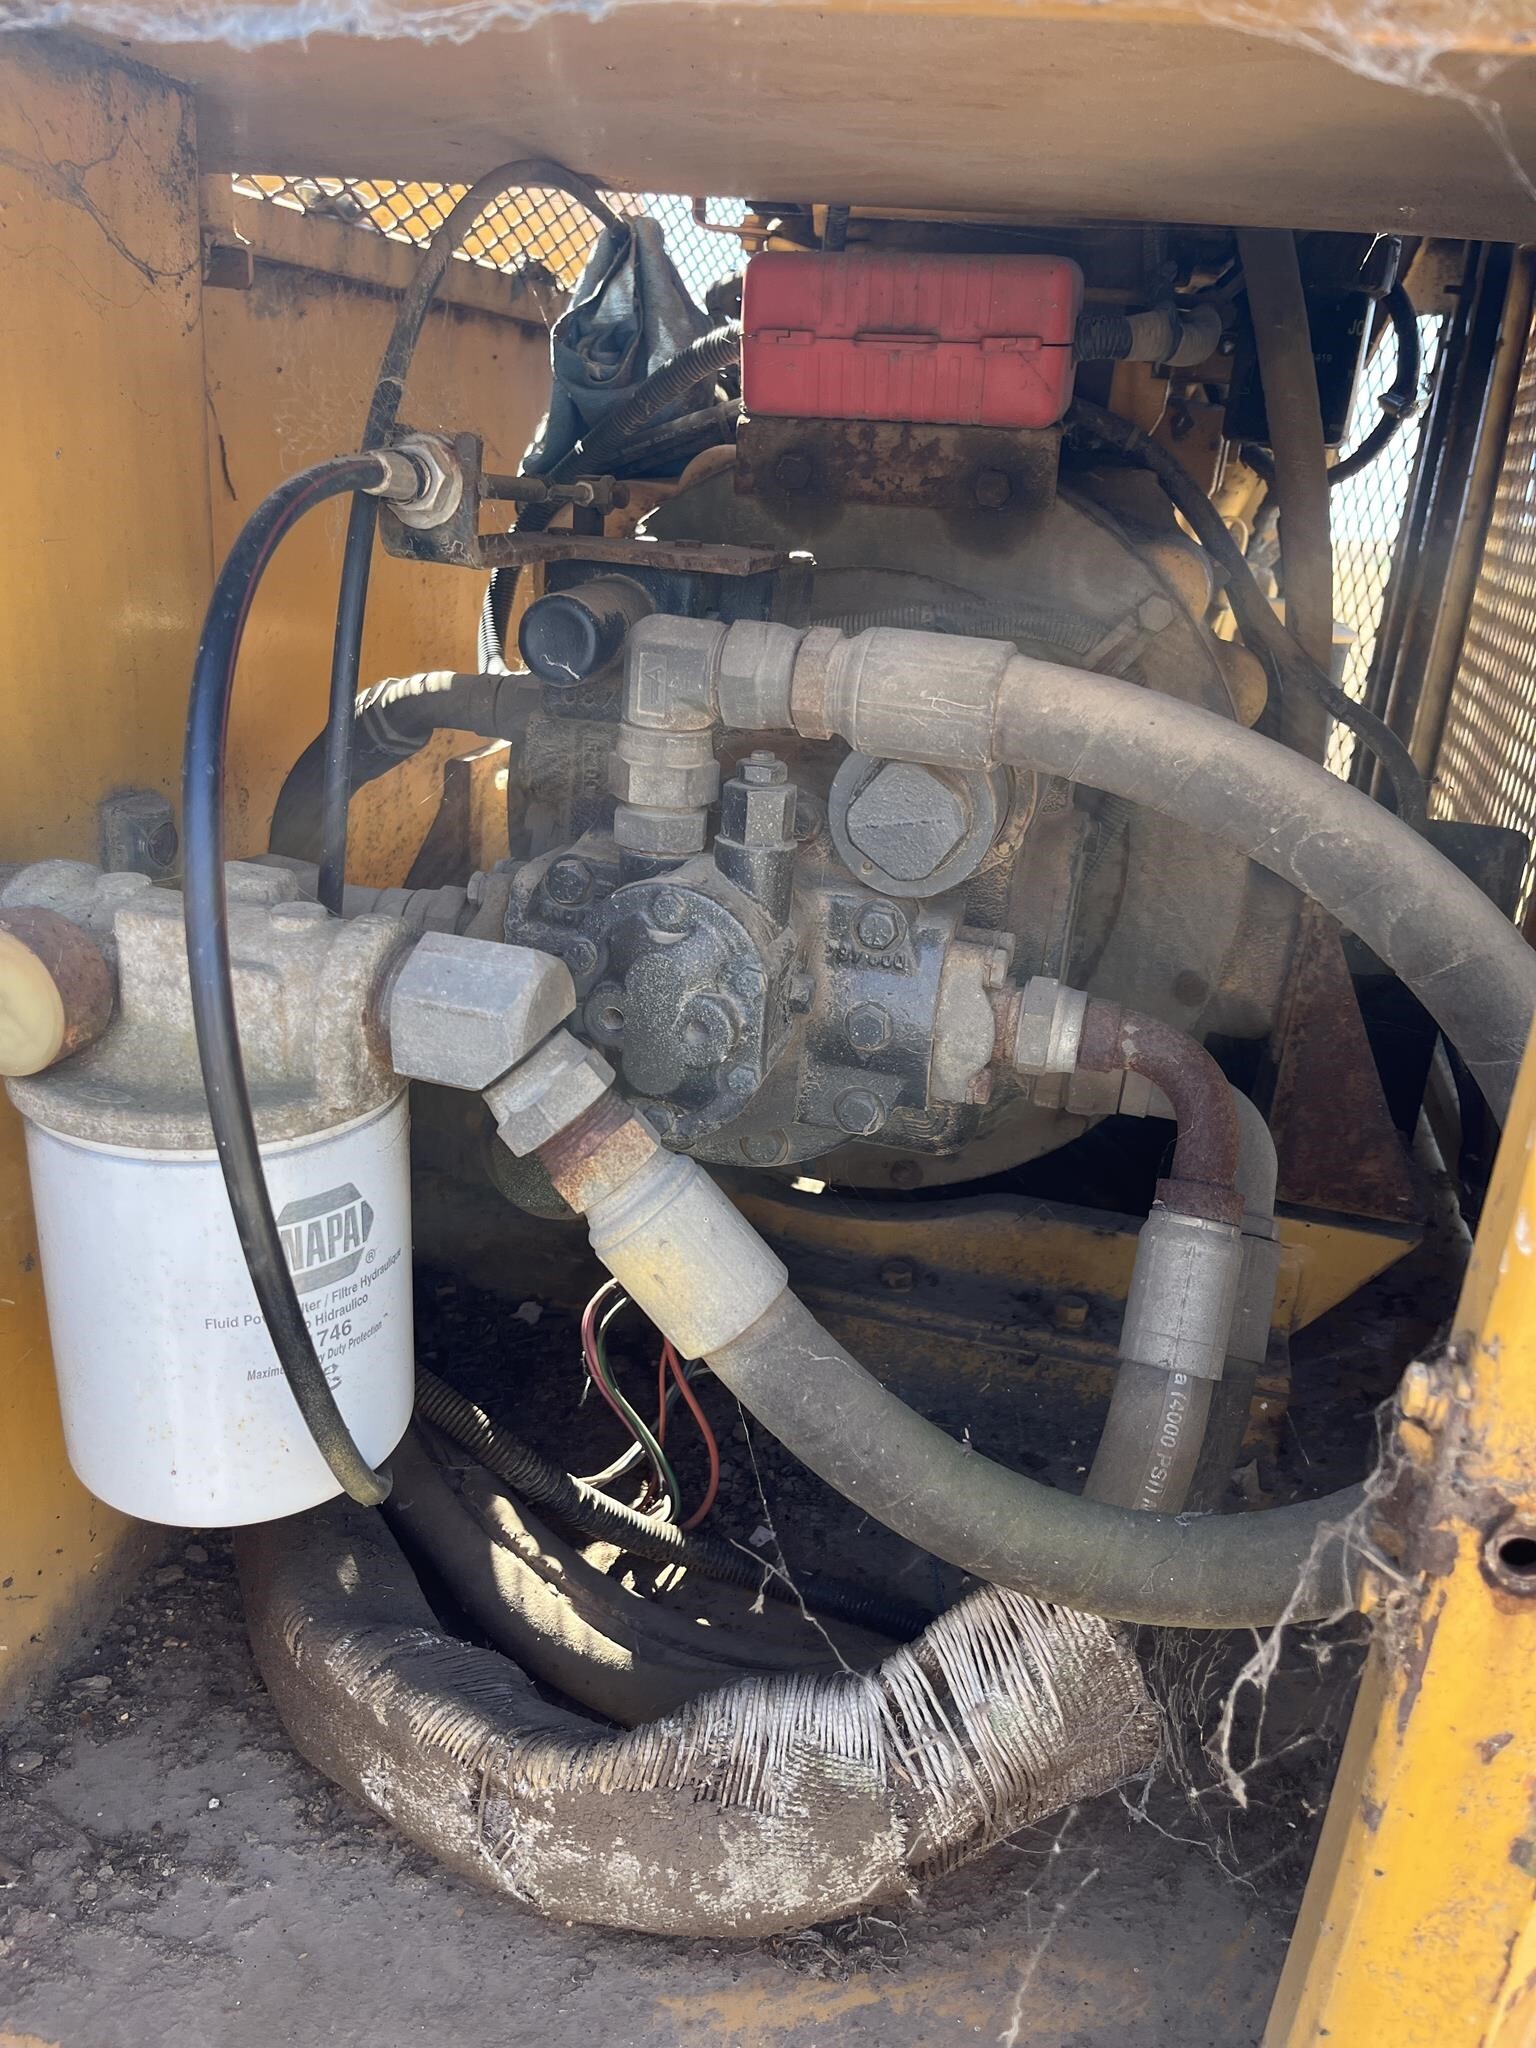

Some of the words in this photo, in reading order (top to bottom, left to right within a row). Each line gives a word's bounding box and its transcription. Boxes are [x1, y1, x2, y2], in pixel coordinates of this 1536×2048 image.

[281, 1206, 361, 1271] NAPA
[205, 1316, 239, 1329] Fluid
[332, 1284, 357, 1303] Filtre
[315, 1293, 368, 1326] Hidraulico
[327, 1343, 346, 1359] Duty
[1160, 1390, 1187, 1448] (4000
